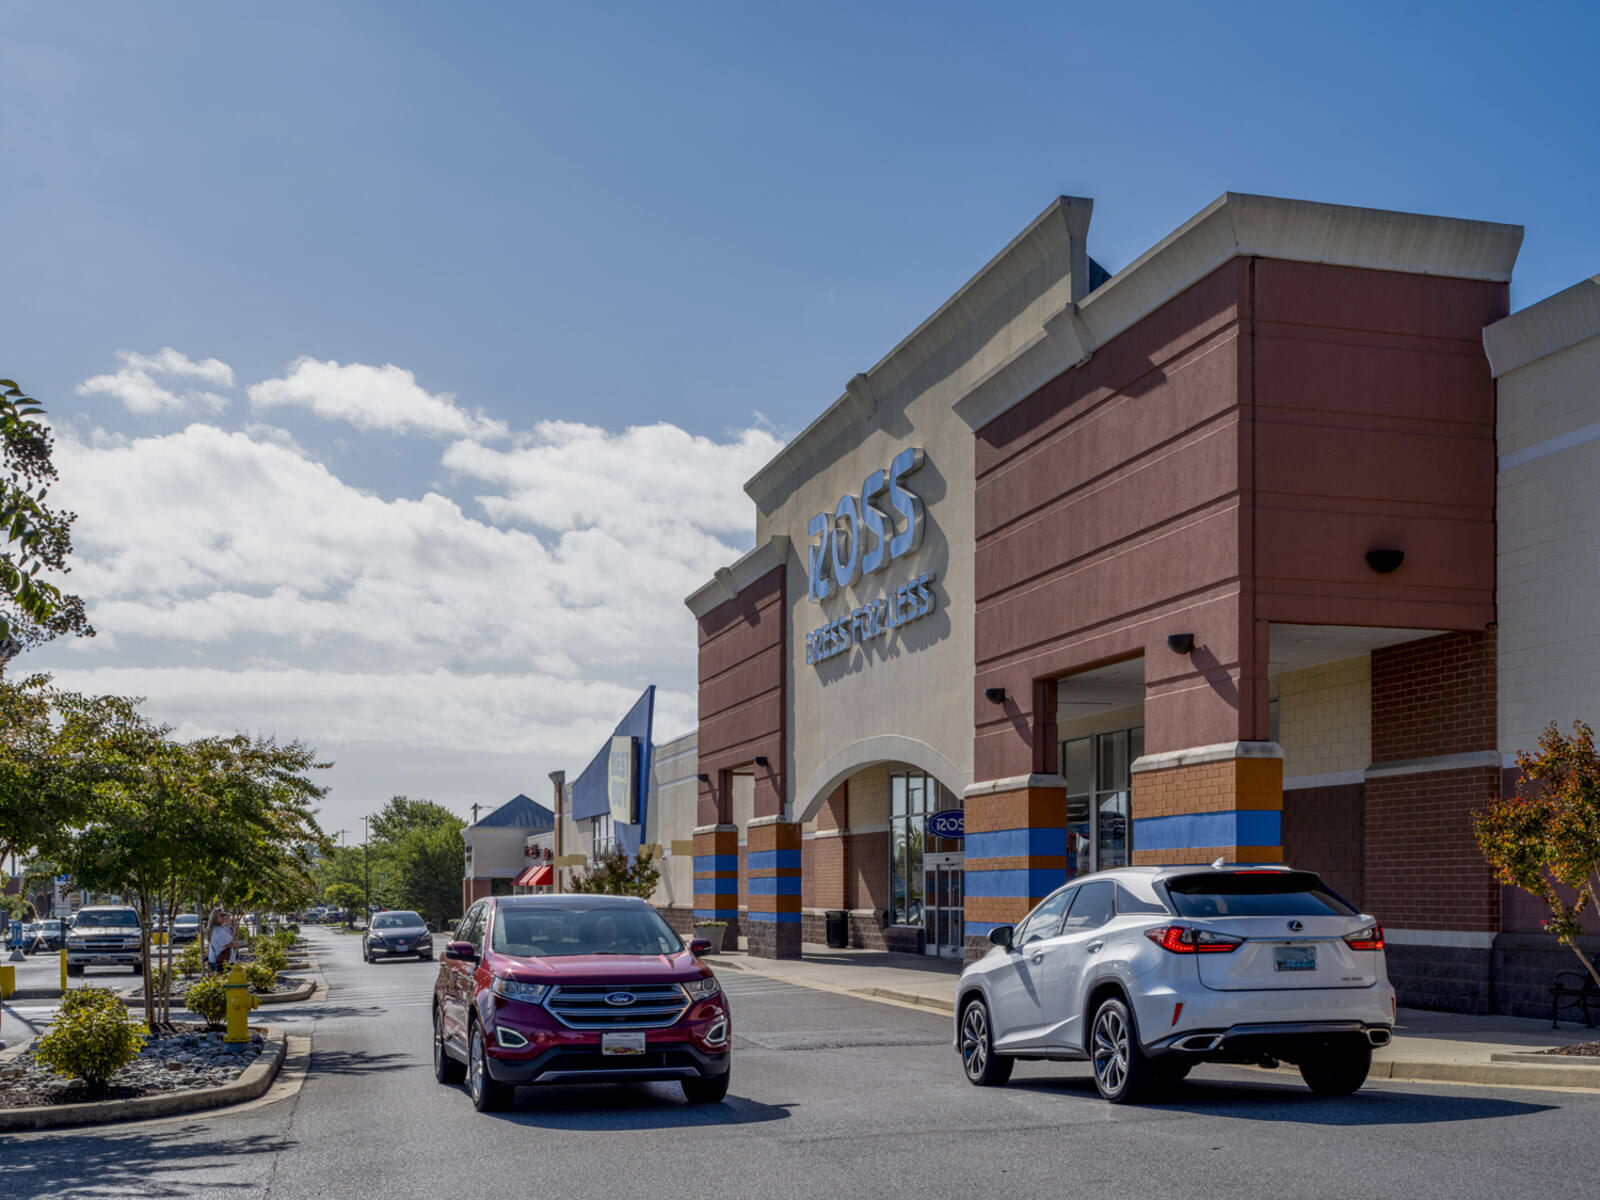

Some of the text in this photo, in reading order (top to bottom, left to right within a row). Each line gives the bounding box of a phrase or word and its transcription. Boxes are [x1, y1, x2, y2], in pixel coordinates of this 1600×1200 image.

[808, 447, 922, 604] ROSS
[806, 573, 933, 665] DRESS FOR LESS
[611, 751, 630, 777] BEST
[611, 781, 629, 808] BUY
[936, 818, 964, 831] ROS
